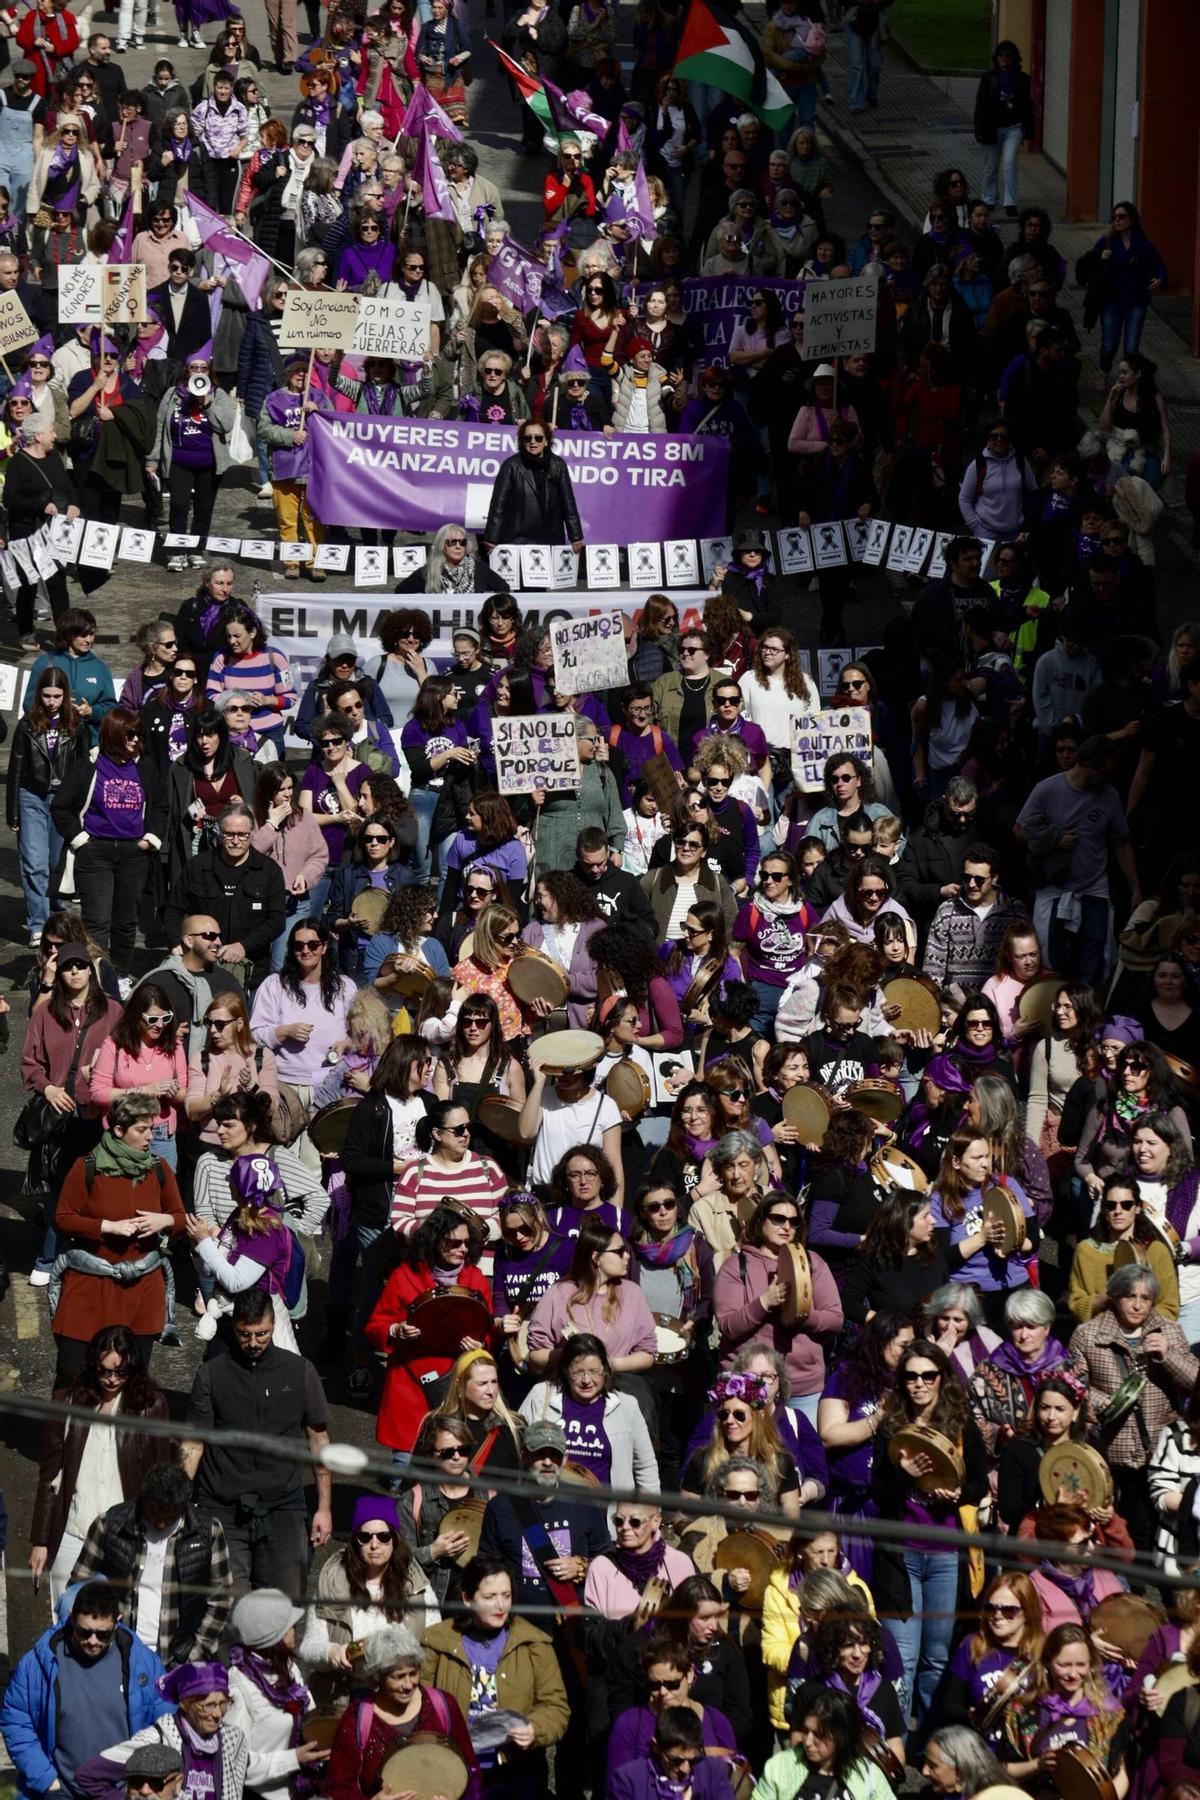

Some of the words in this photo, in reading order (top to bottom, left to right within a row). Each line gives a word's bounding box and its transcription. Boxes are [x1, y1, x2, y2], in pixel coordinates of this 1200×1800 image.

[60, 281, 76, 298] NO
[72, 266, 87, 283] ME
[61, 274, 96, 319] IGNORES
[811, 285, 876, 303] MAYORES
[290, 297, 312, 316] Soy
[364, 304, 424, 323] OMOS
[0, 313, 24, 330] NOS
[810, 308, 875, 328] ACTIVISTAS
[286, 330, 303, 339] un
[413, 327, 425, 342] Y
[835, 325, 843, 340] Y
[352, 337, 427, 356] UERRERAS
[806, 338, 871, 357] FEMINISTAS
[332, 420, 459, 448] MUYERES
[664, 442, 704, 462] 8M
[346, 447, 502, 478] AVANZAMO
[627, 468, 686, 487] TIRA
[271, 607, 318, 637] EL
[562, 649, 577, 668] tu
[497, 723, 512, 741] SI
[520, 721, 547, 739] NO
[551, 721, 575, 738] LO
[795, 716, 818, 730] NOS
[829, 714, 850, 727] LO
[798, 733, 870, 751] QUITARON
[500, 757, 576, 777] PORQUE
[804, 764, 823, 783] EL
